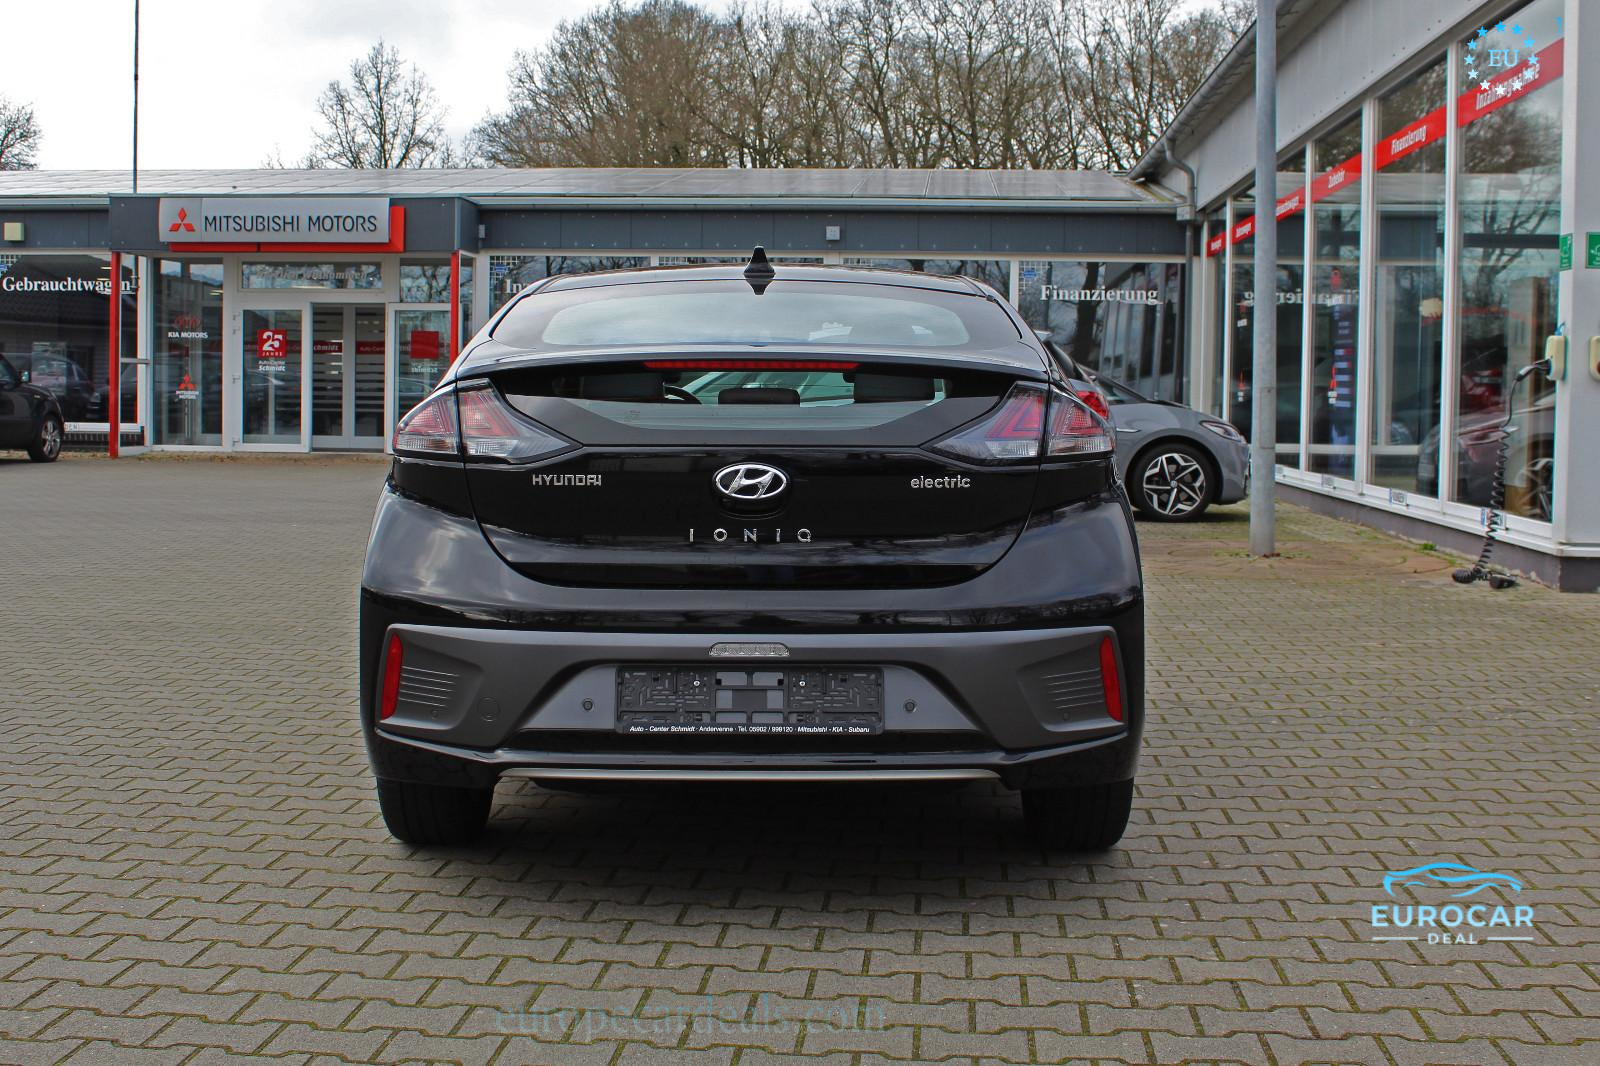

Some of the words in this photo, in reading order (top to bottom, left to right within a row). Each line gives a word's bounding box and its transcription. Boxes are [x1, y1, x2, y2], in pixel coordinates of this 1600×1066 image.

[204, 215, 300, 232] MITSUBISHI
[308, 215, 378, 232] MOTORS
[2, 277, 131, 294] Gebrauchtwagn
[1040, 285, 1159, 304] Finanzierung
[262, 331, 283, 351] 25
[532, 474, 602, 486] HYUNDAI
[910, 475, 972, 489] electric
[688, 528, 813, 543] IONIQ
